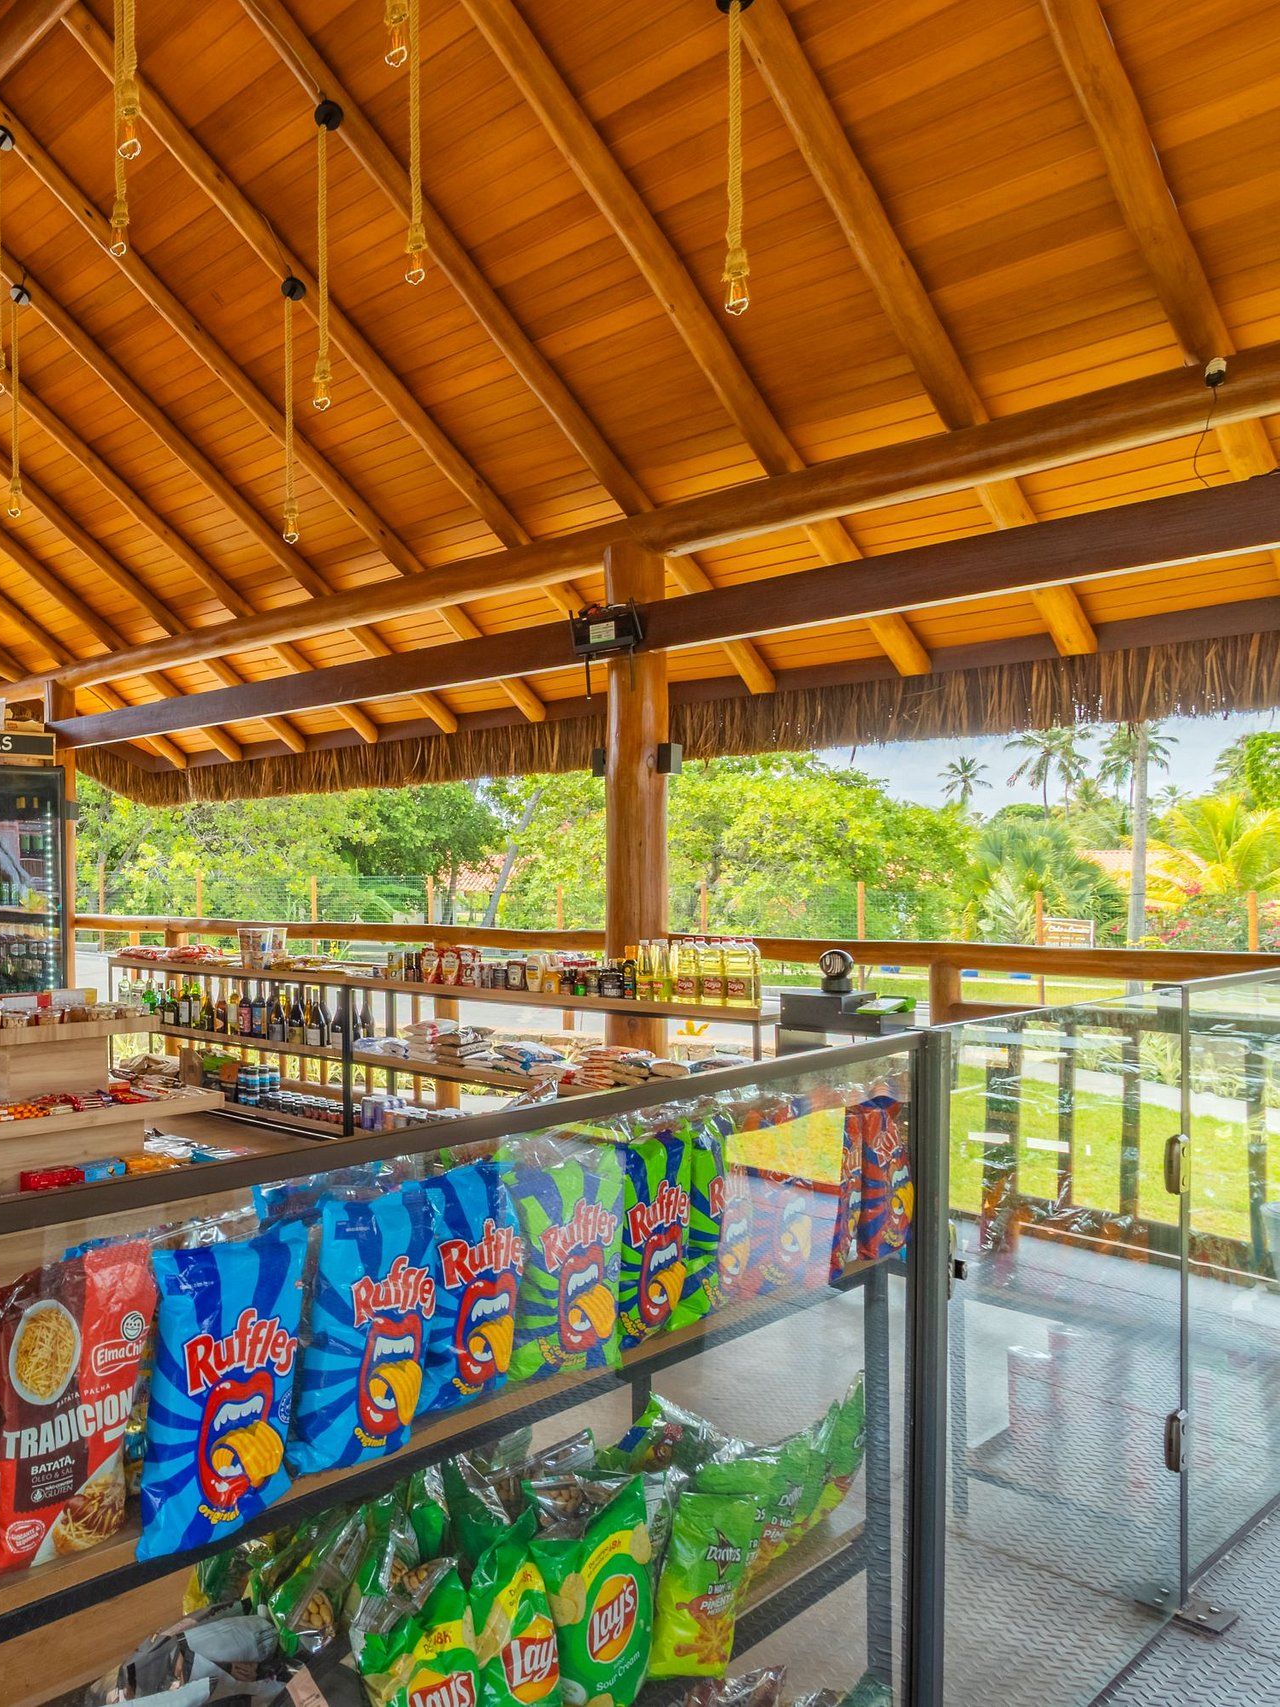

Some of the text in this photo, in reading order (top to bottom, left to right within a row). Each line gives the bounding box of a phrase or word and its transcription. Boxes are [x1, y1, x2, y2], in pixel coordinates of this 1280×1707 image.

[540, 1198, 618, 1273] Ruffles
[183, 1307, 298, 1396] Ruffles
[83, 1383, 111, 1396] PALHA
[354, 1427, 387, 1447] original
[31, 1455, 75, 1475] BATATA,
[62, 1467, 73, 1476] SAL
[198, 1503, 240, 1525] original
[706, 1546, 741, 1562] Doritos
[593, 1583, 636, 1652] Lay's
[596, 1651, 641, 1691] Sour Cream
